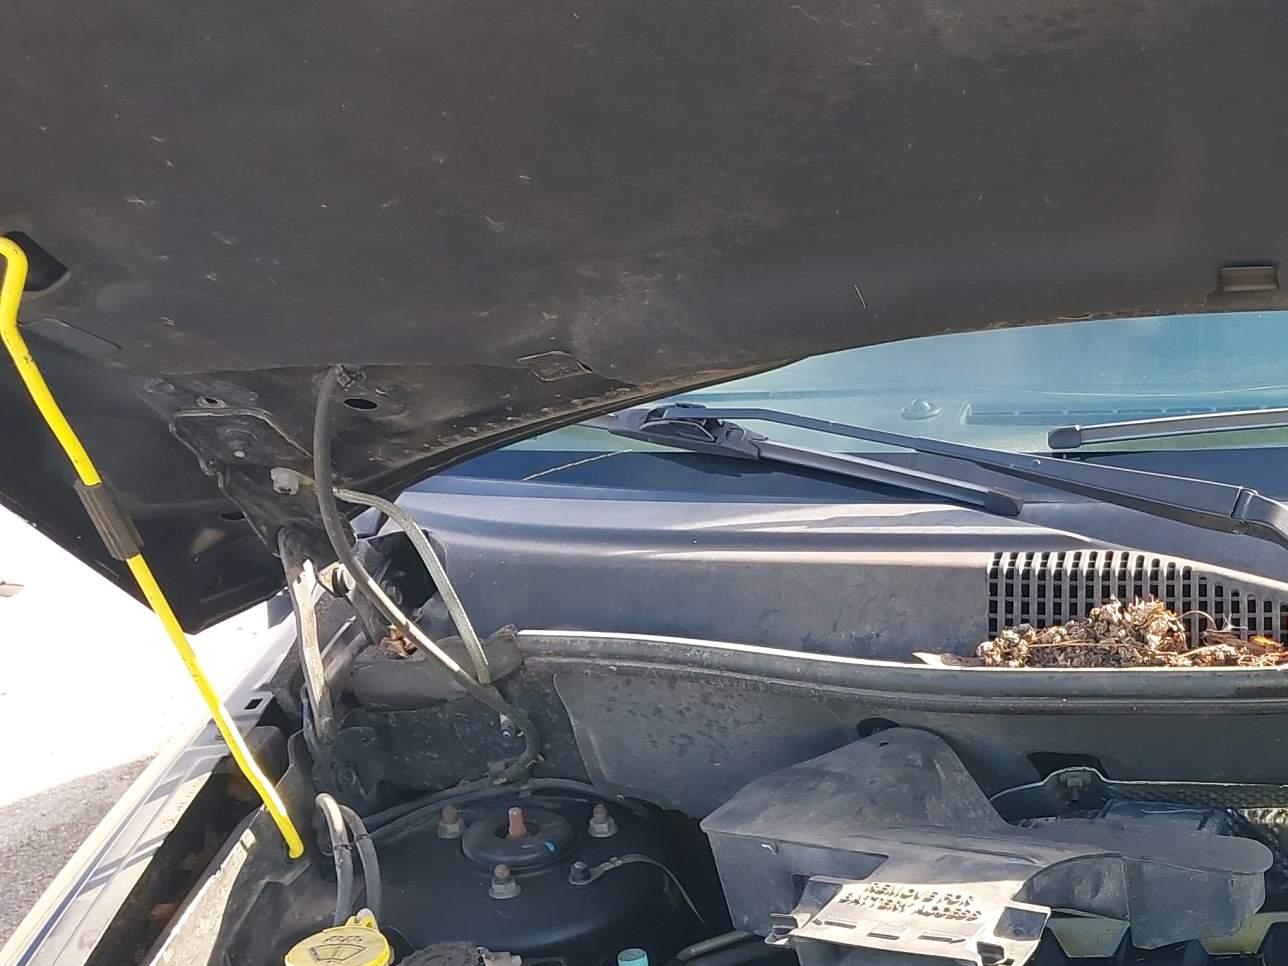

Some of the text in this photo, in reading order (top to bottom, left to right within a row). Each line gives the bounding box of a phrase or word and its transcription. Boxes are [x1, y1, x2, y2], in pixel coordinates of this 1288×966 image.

[838, 893, 982, 921] BATTERY ACCESS
[864, 882, 974, 907] REMOVE FOR
